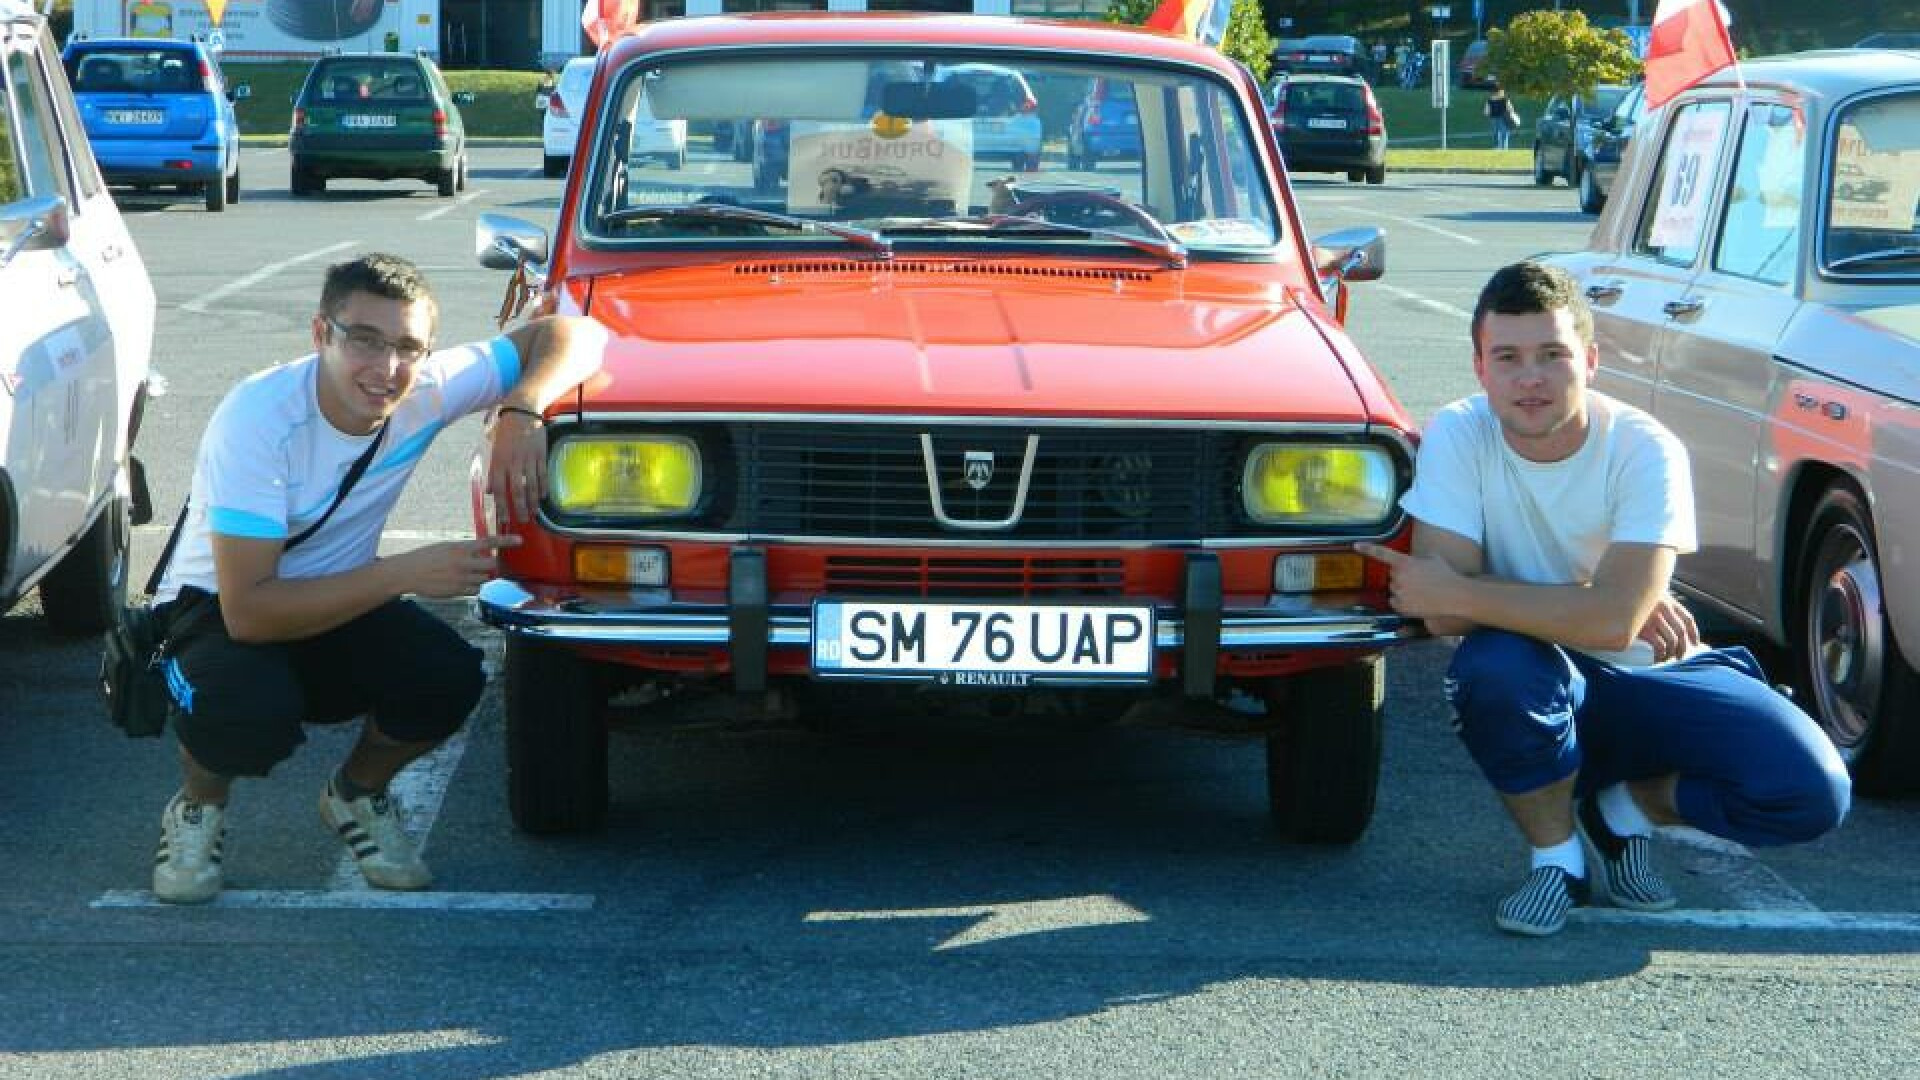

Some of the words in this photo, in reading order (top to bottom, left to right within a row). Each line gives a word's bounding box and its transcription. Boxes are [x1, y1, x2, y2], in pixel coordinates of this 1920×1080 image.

[849, 609, 927, 663] SM
[951, 611, 1015, 663] 76
[1030, 612, 1144, 665] UAP
[955, 672, 1031, 686] RENAULT
